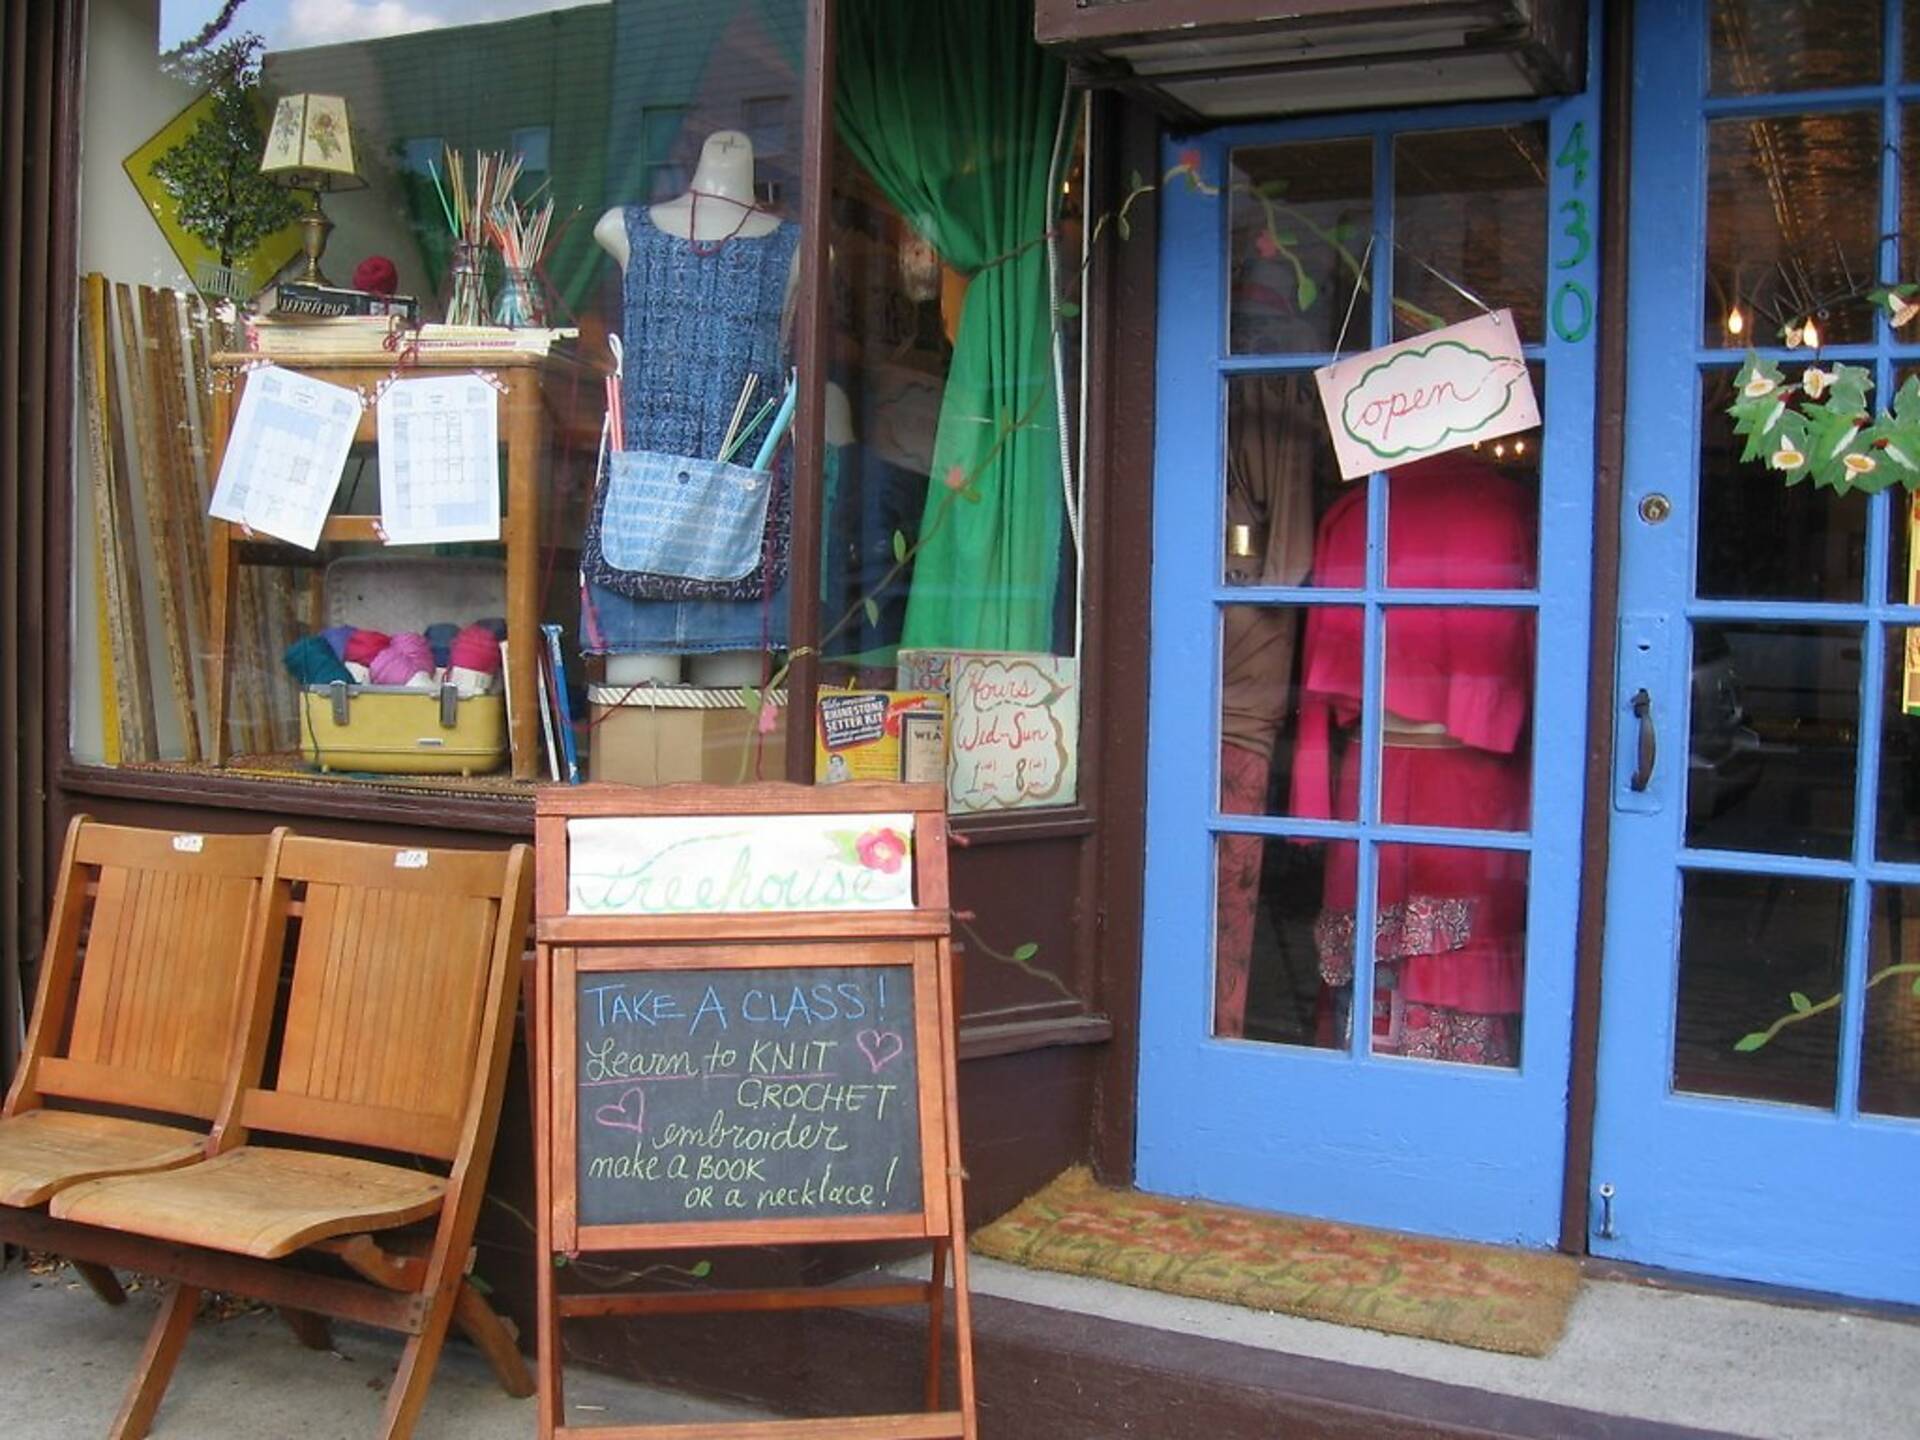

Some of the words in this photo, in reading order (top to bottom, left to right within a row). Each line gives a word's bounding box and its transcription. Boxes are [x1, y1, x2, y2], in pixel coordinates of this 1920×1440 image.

[1552, 121, 1593, 343] 430
[1353, 381, 1474, 440] open
[967, 668, 1035, 705] Hours
[825, 700, 884, 721] RHINESTONE
[864, 712, 883, 726] KIT
[583, 983, 685, 1028] TAKE
[689, 985, 728, 1036] A
[585, 1038, 699, 1082] Learn
[704, 1041, 736, 1071] to
[748, 1040, 838, 1074] KNIT
[737, 1079, 897, 1120] CROCHET
[652, 1109, 848, 1152] embroider
[588, 1142, 660, 1181] make
[696, 1154, 766, 1182] BOOK
[725, 1187, 746, 1208] a
